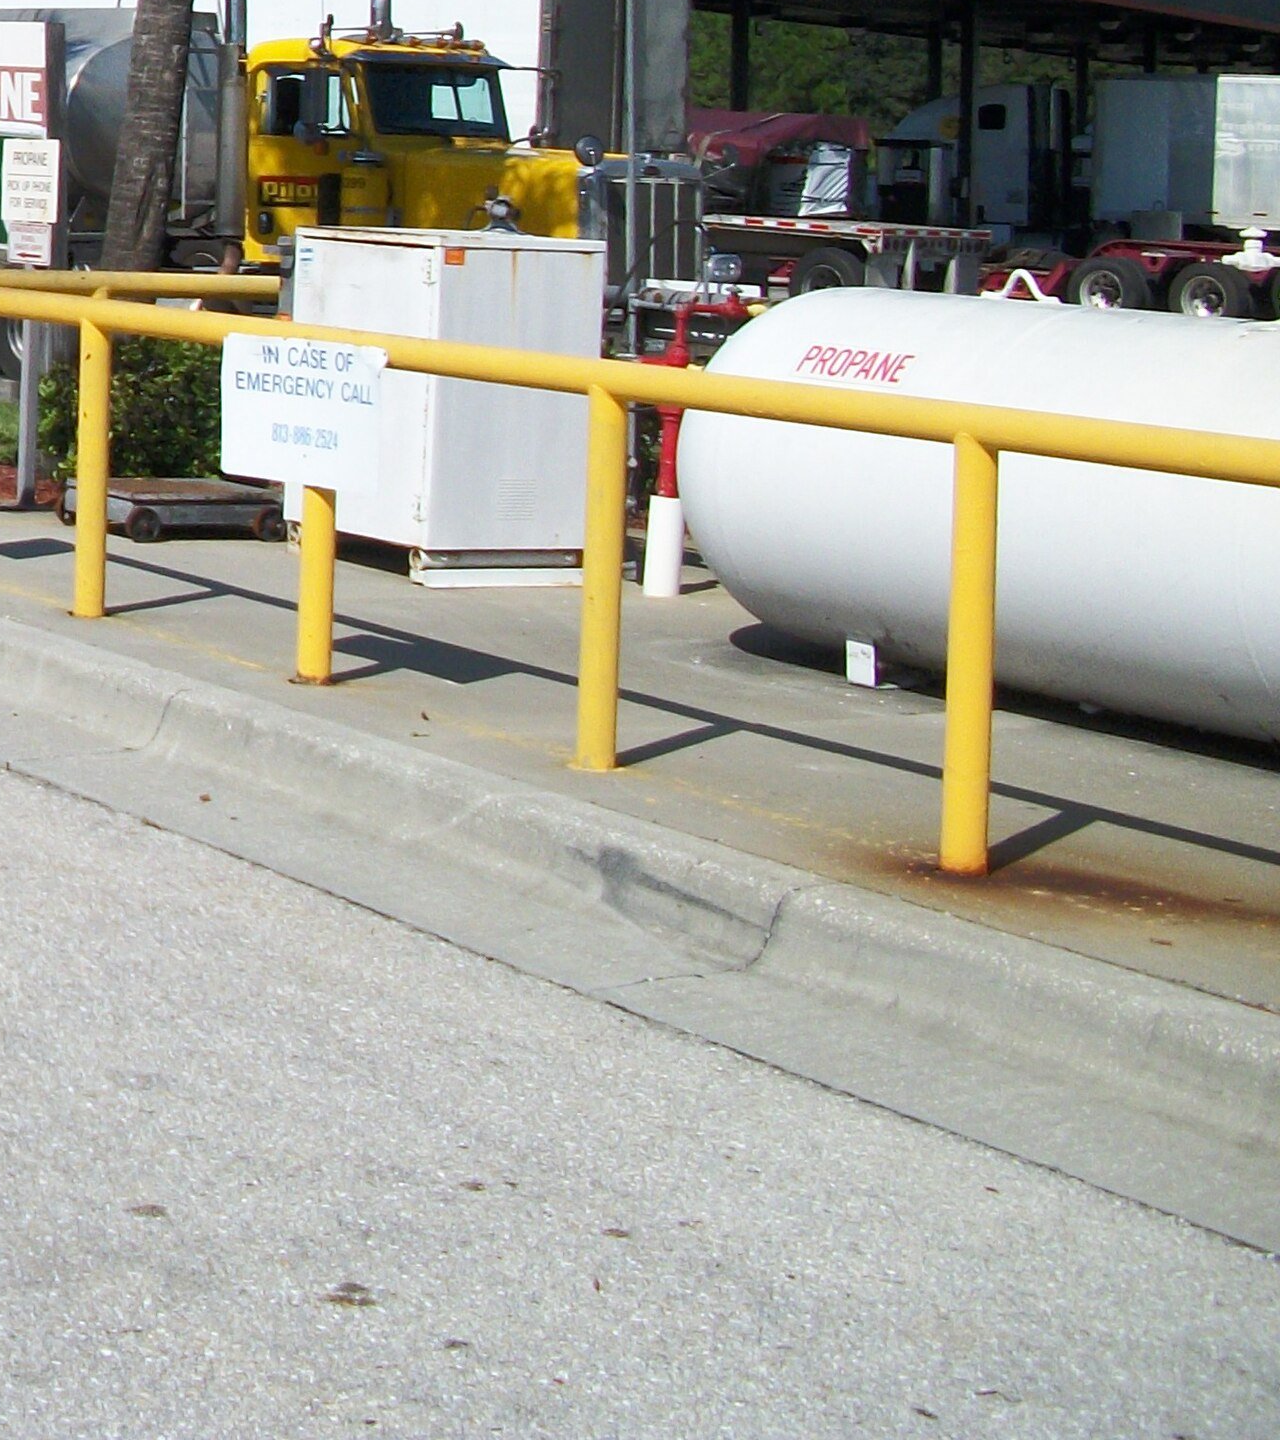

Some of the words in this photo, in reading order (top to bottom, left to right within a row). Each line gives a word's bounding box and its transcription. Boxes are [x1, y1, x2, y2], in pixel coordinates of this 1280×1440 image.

[13, 150, 48, 167] PROPANE
[262, 181, 318, 203] Pilo
[262, 345, 279, 364] IN
[288, 347, 328, 370] CASE
[335, 351, 354, 372] OF
[796, 345, 916, 383] PROPANE
[235, 370, 334, 400] EMERGENCY
[341, 382, 374, 406] CALL
